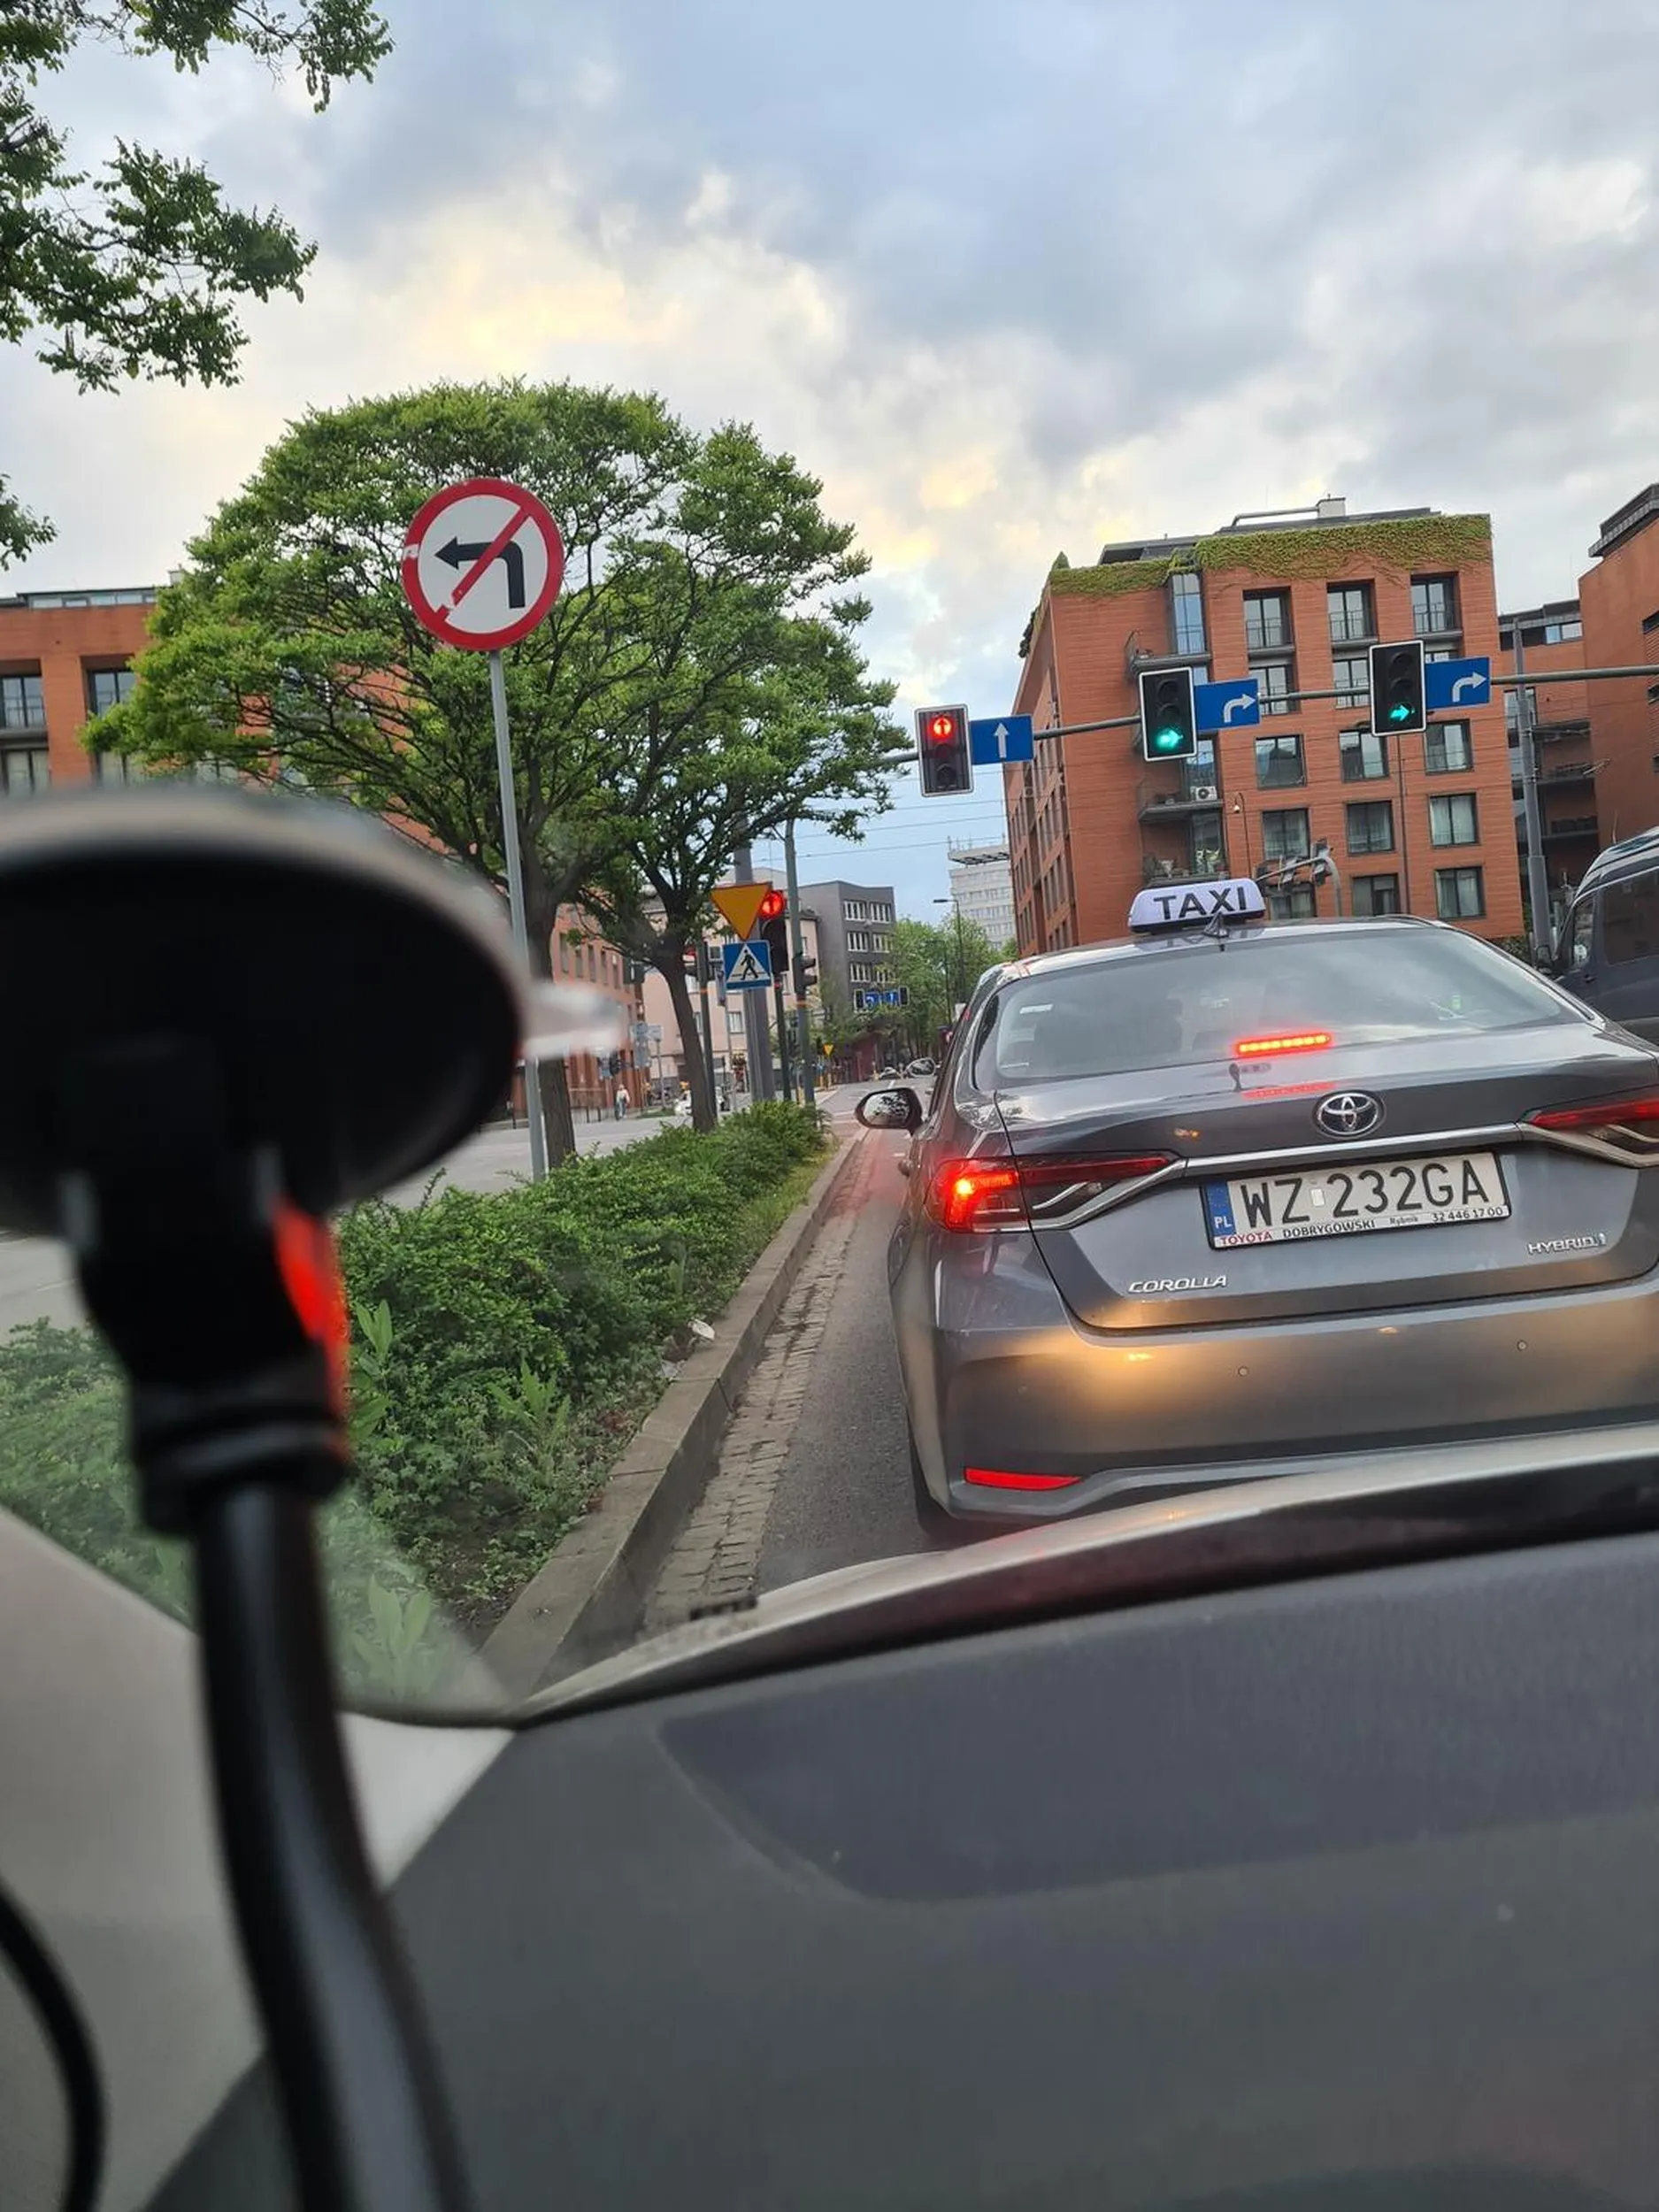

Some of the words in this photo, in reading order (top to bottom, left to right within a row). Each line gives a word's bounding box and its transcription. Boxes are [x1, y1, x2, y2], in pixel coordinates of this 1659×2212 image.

[1153, 887, 1247, 920] TAXI
[1240, 1178, 1310, 1228] WZ
[1327, 1159, 1490, 1218] 232GA
[1214, 1216, 1233, 1229] PL
[1220, 1231, 1272, 1246] TOYOTA
[1283, 1220, 1375, 1238] DOBRYGOWSKI
[1527, 1236, 1599, 1255] HYBRID
[1128, 1274, 1227, 1293] COROLLA
